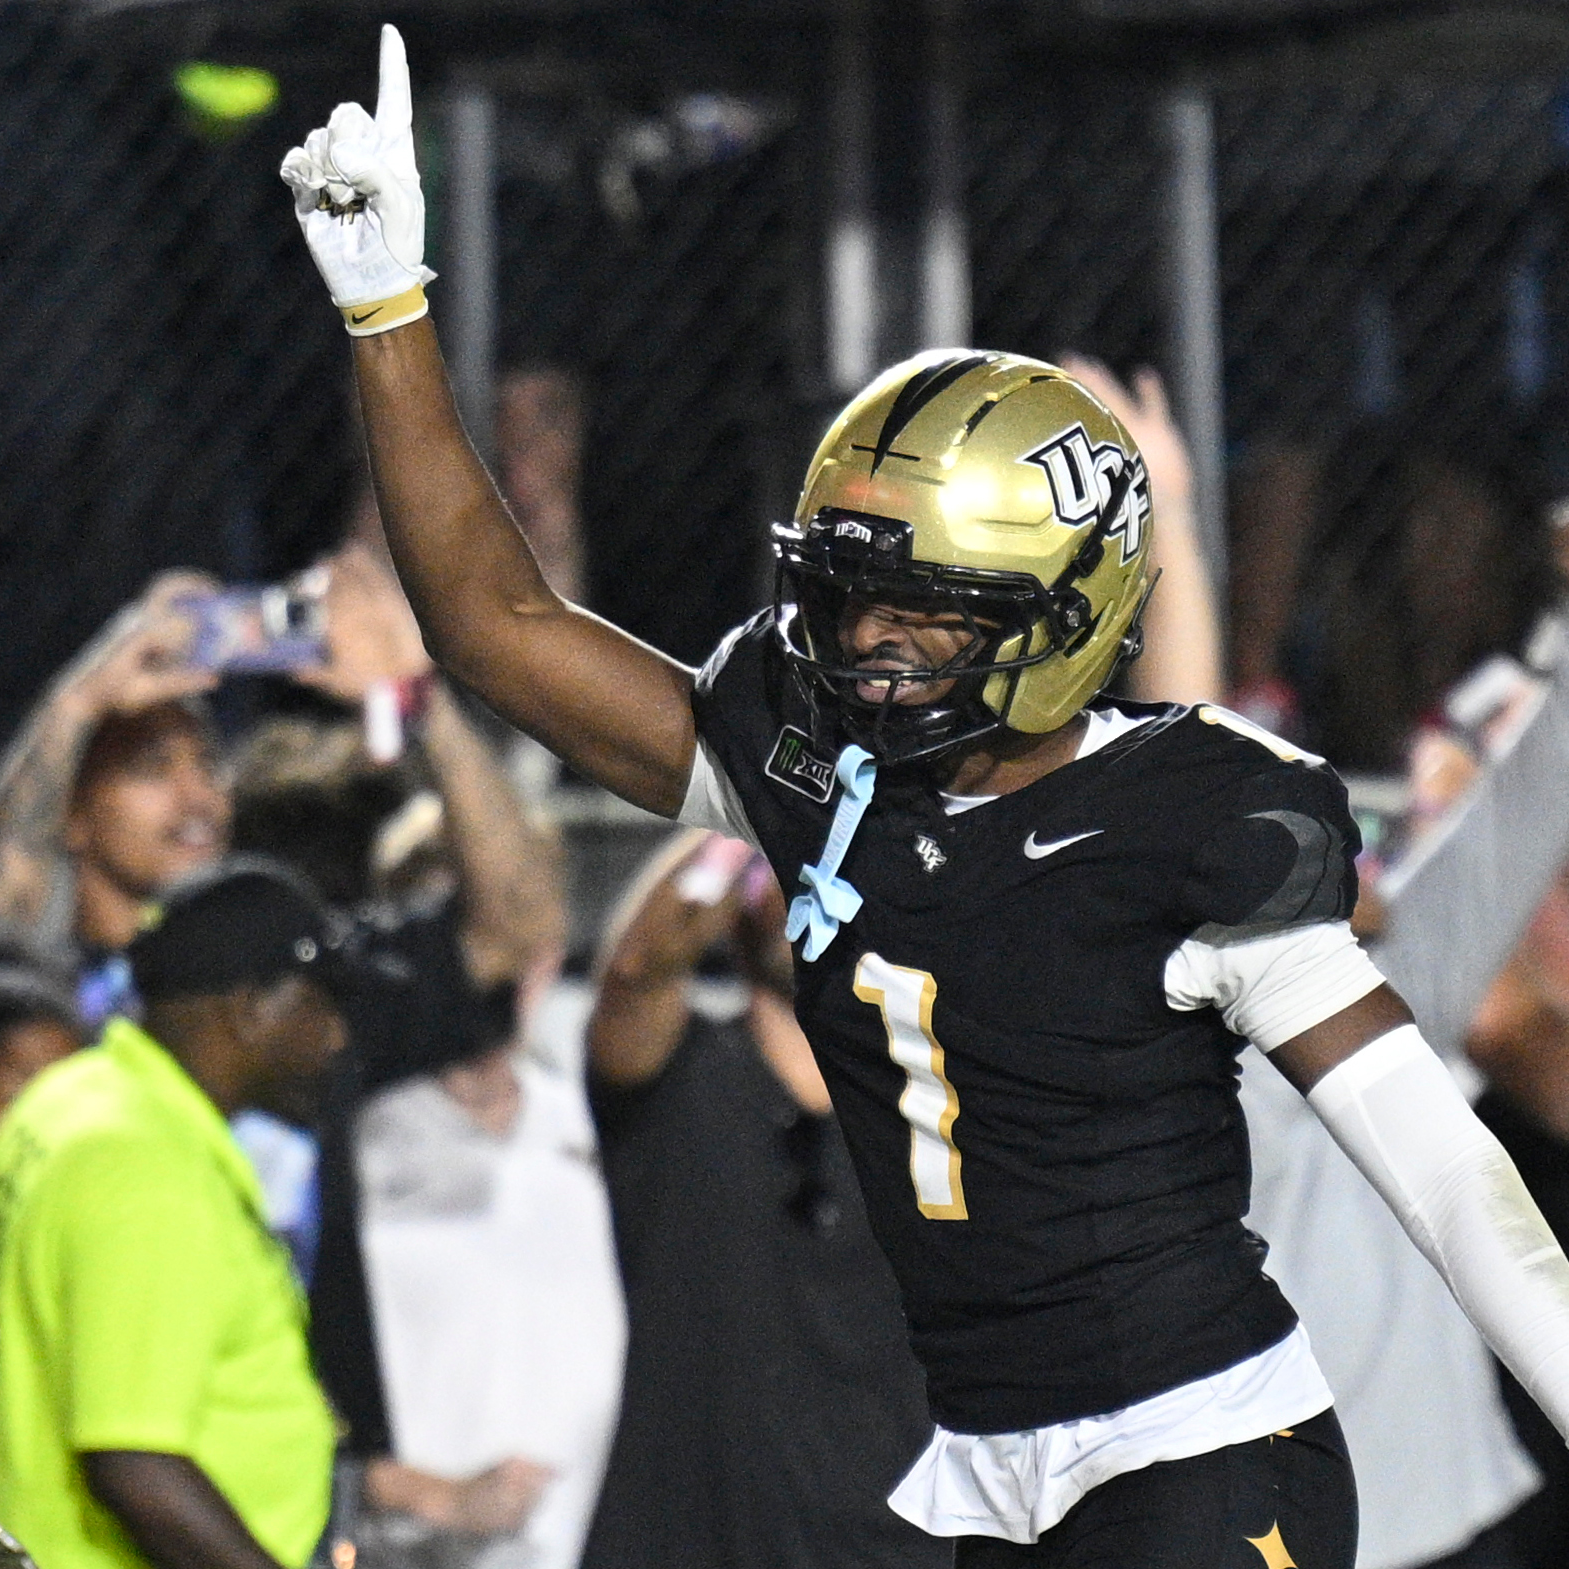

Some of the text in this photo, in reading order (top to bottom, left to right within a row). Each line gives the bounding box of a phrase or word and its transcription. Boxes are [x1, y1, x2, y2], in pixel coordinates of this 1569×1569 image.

[1015, 420, 1152, 568] UCF
[917, 834, 948, 873] UCF
[853, 952, 969, 1221] 1
